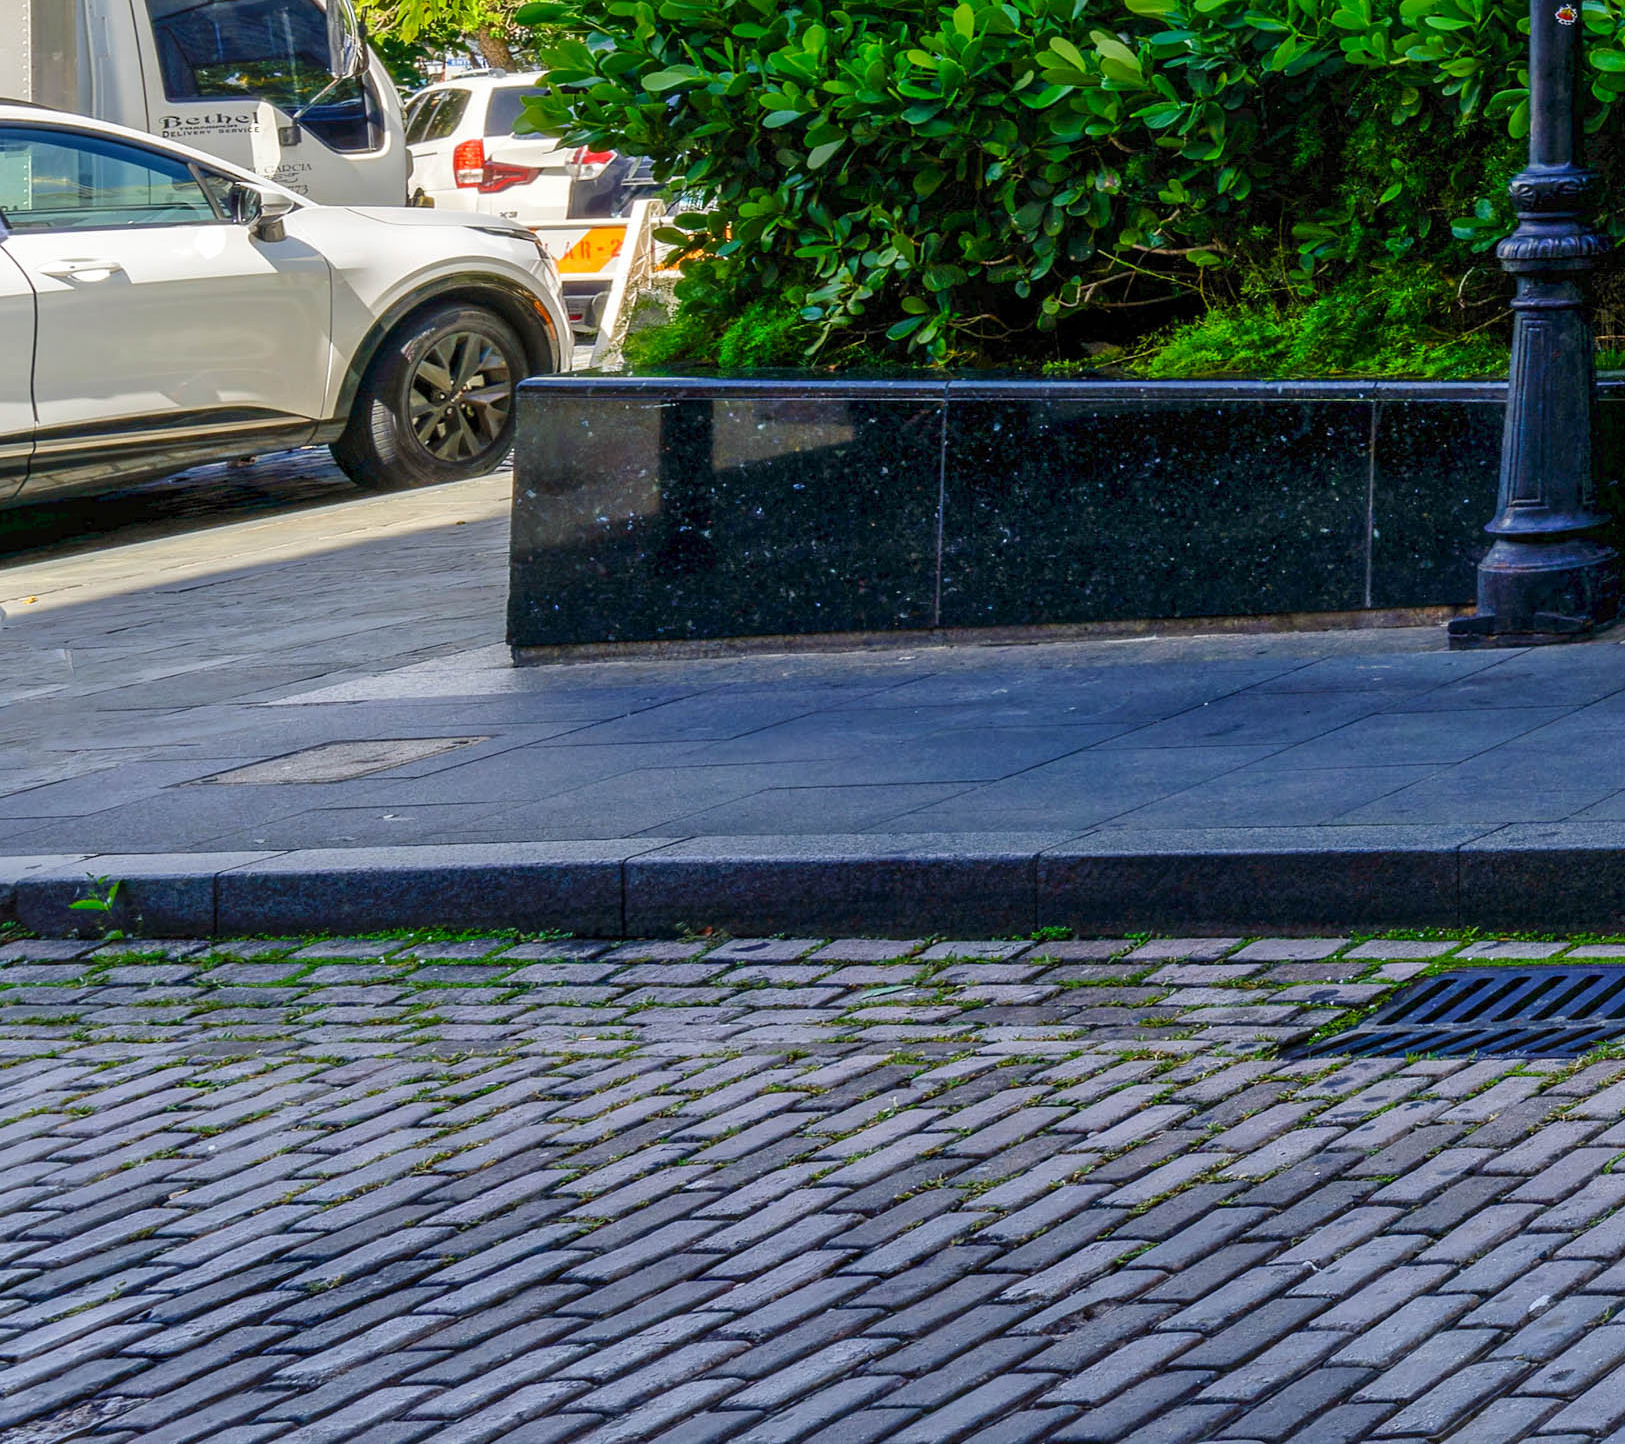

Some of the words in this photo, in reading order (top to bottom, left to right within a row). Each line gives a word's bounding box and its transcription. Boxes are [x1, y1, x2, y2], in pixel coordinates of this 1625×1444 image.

[159, 111, 261, 129] Bethel
[162, 128, 212, 139] DELIVERY
[218, 126, 261, 135] SERVICE
